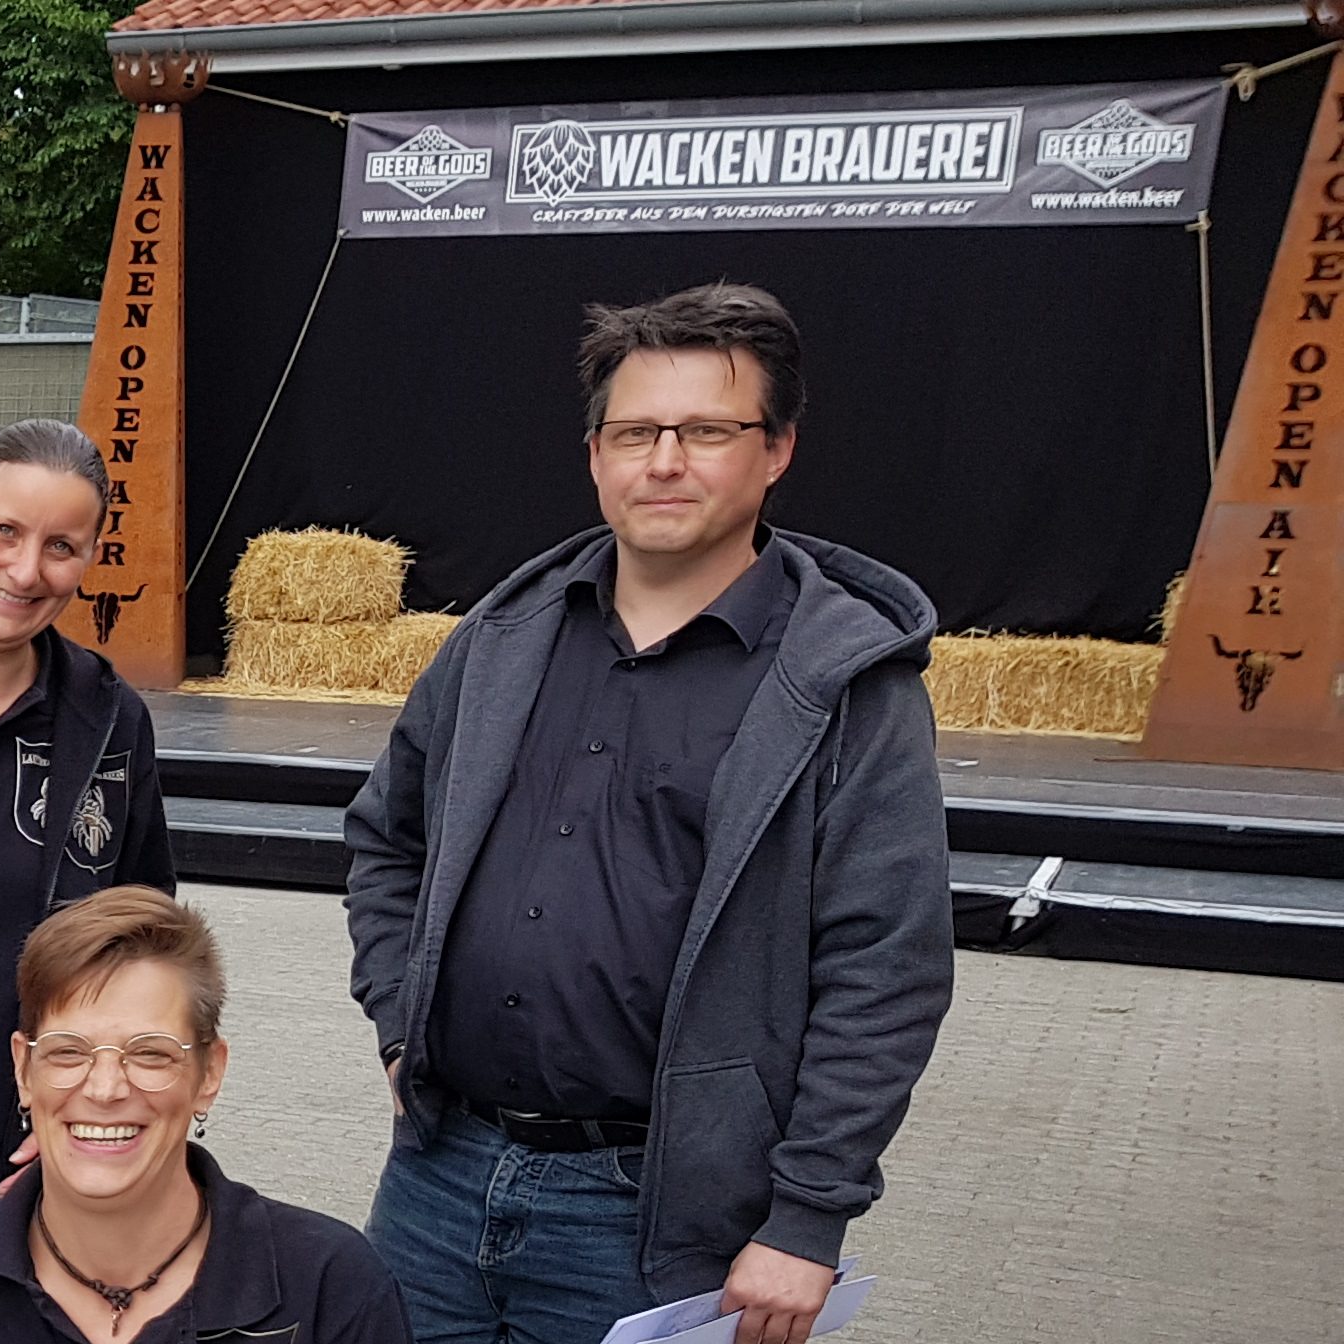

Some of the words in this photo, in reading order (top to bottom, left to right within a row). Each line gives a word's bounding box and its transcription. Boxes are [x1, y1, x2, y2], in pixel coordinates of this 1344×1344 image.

[370, 156, 419, 176] BEER
[438, 153, 486, 175] GODS
[600, 128, 777, 187] WACKEN
[780, 121, 1008, 183] BRAUEREI
[1126, 130, 1185, 156] GODS
[362, 204, 486, 222] www.wacken.beer
[630, 206, 664, 220] AUS
[1031, 185, 1185, 210] www.wacken.beer
[123, 144, 172, 328] WACKEN
[109, 345, 147, 463] OPEN
[1268, 342, 1327, 488] OPEN
[97, 480, 132, 566] AIR
